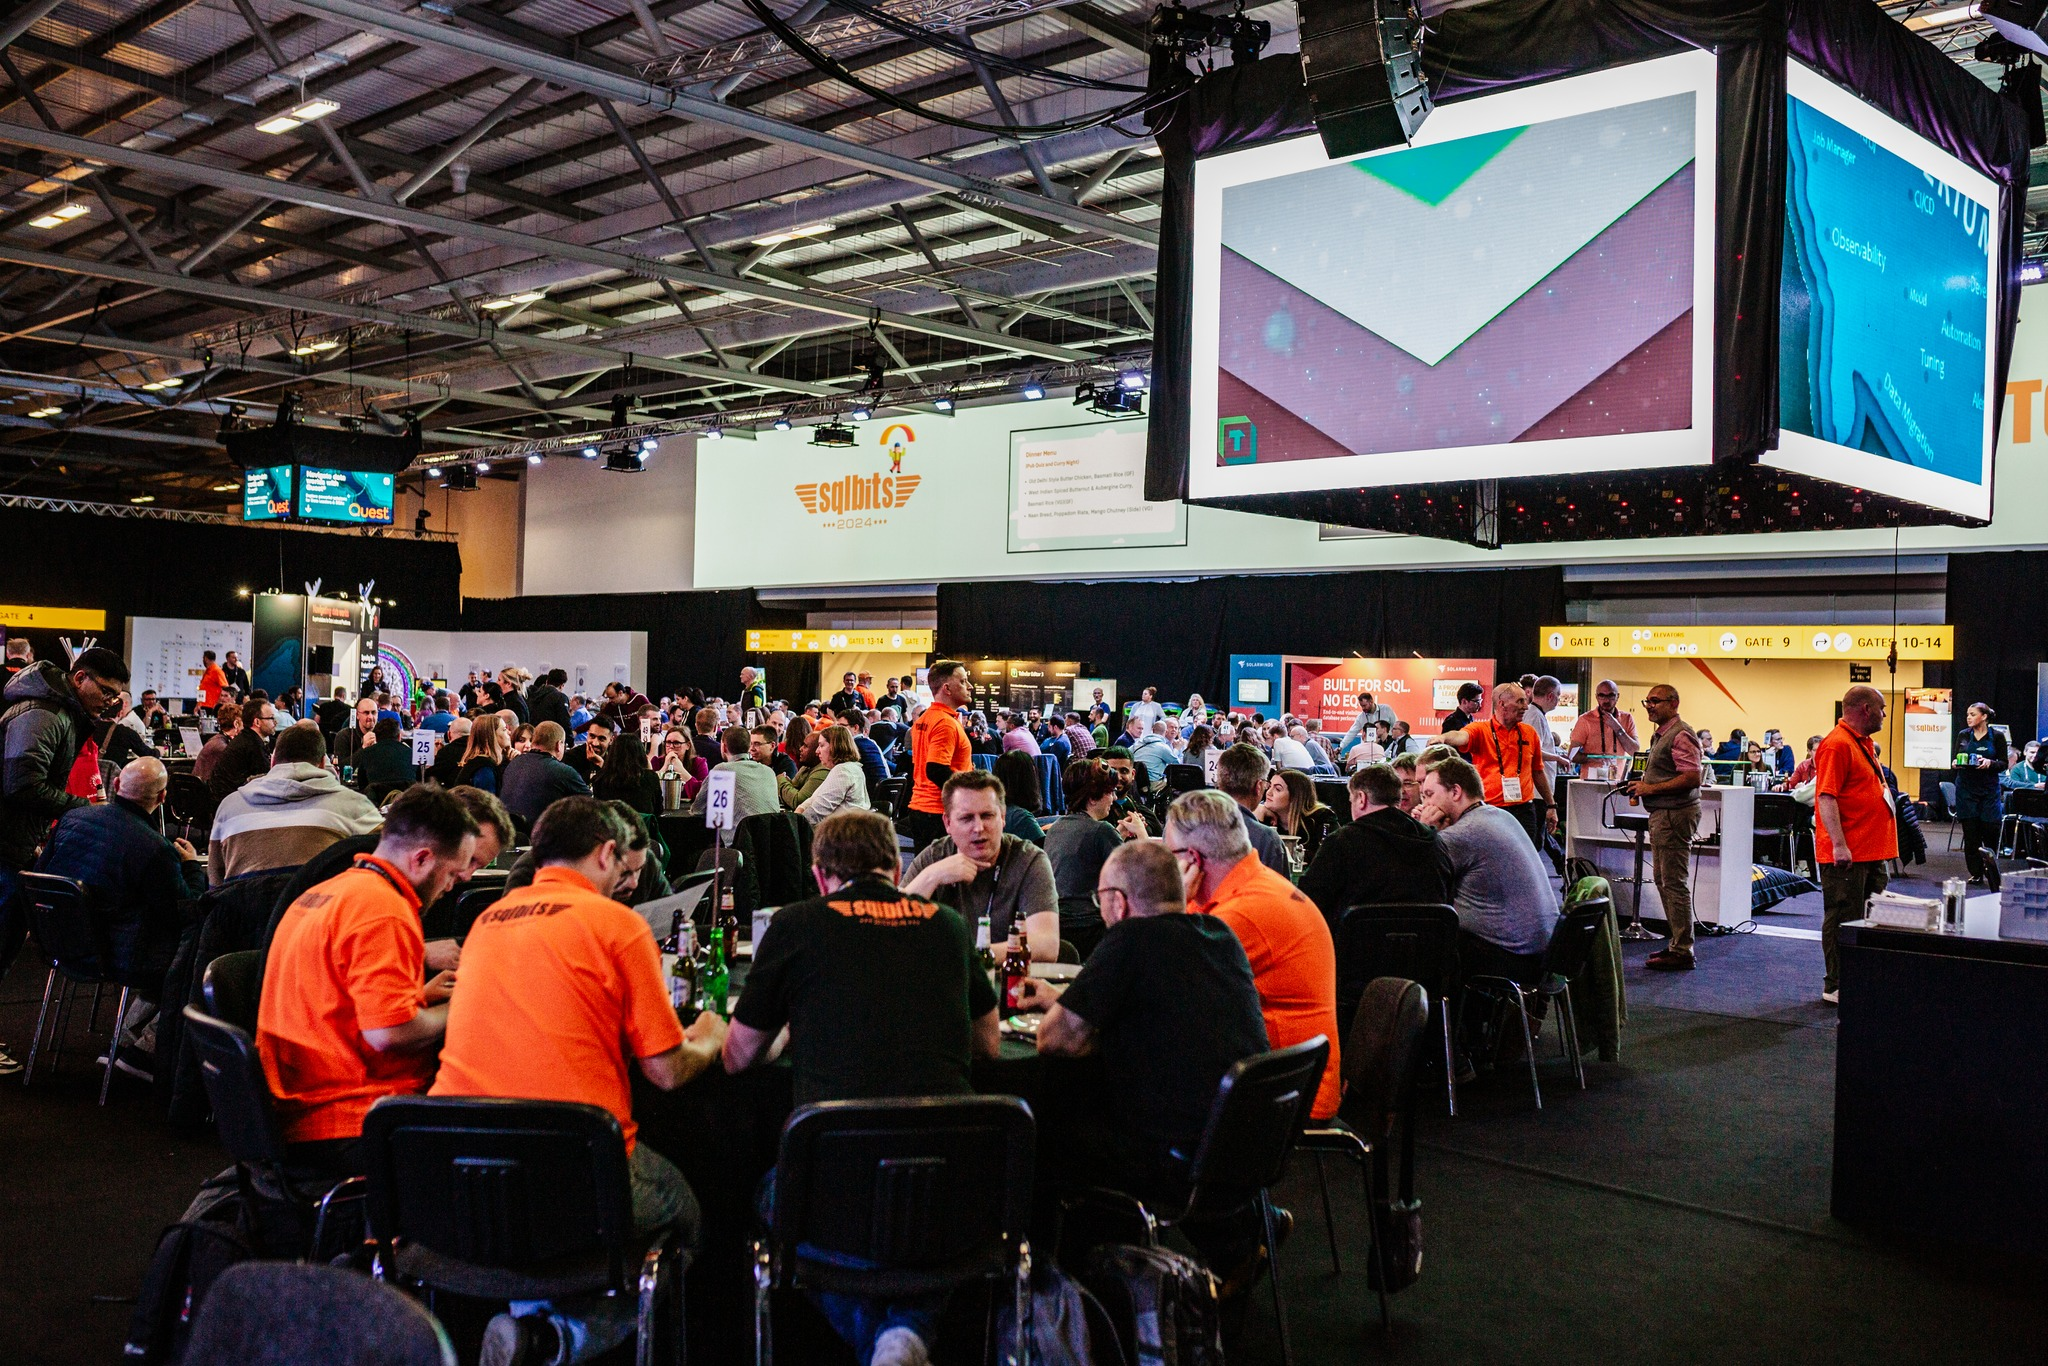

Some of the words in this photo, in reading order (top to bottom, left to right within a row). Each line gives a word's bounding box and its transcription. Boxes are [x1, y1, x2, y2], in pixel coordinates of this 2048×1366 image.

[1812, 130, 1825, 149] Job
[1826, 138, 1856, 166] Manager
[1914, 190, 1935, 215] CI/CD
[1831, 227, 1887, 274] Observability
[1941, 319, 1982, 352] Automation
[1920, 347, 1945, 380] Tuning
[1883, 372, 1902, 410] Data
[1901, 401, 1935, 463] Migration
[1054, 460, 1065, 468] Curry
[1066, 459, 1080, 467] Night)
[819, 472, 894, 515] sqlbits
[1095, 483, 1118, 491] Aubergine
[268, 499, 290, 514] Quest
[348, 502, 390, 520] Quest
[837, 518, 872, 530] 2024
[923, 637, 928, 645] 7
[1570, 638, 1595, 647] GATE
[1603, 637, 1610, 647] 8
[1745, 638, 1773, 647] GATE
[1783, 637, 1790, 648] 9
[1858, 638, 1895, 647] GATES
[1902, 637, 1942, 648] 10-14
[1323, 678, 1356, 692] BUILT
[1358, 679, 1381, 692] FOR
[1383, 679, 1411, 693] SQL.
[1322, 694, 1341, 707] NO
[1916, 724, 1940, 732] sqlbits
[417, 741, 430, 753] 25
[713, 790, 728, 808] 26
